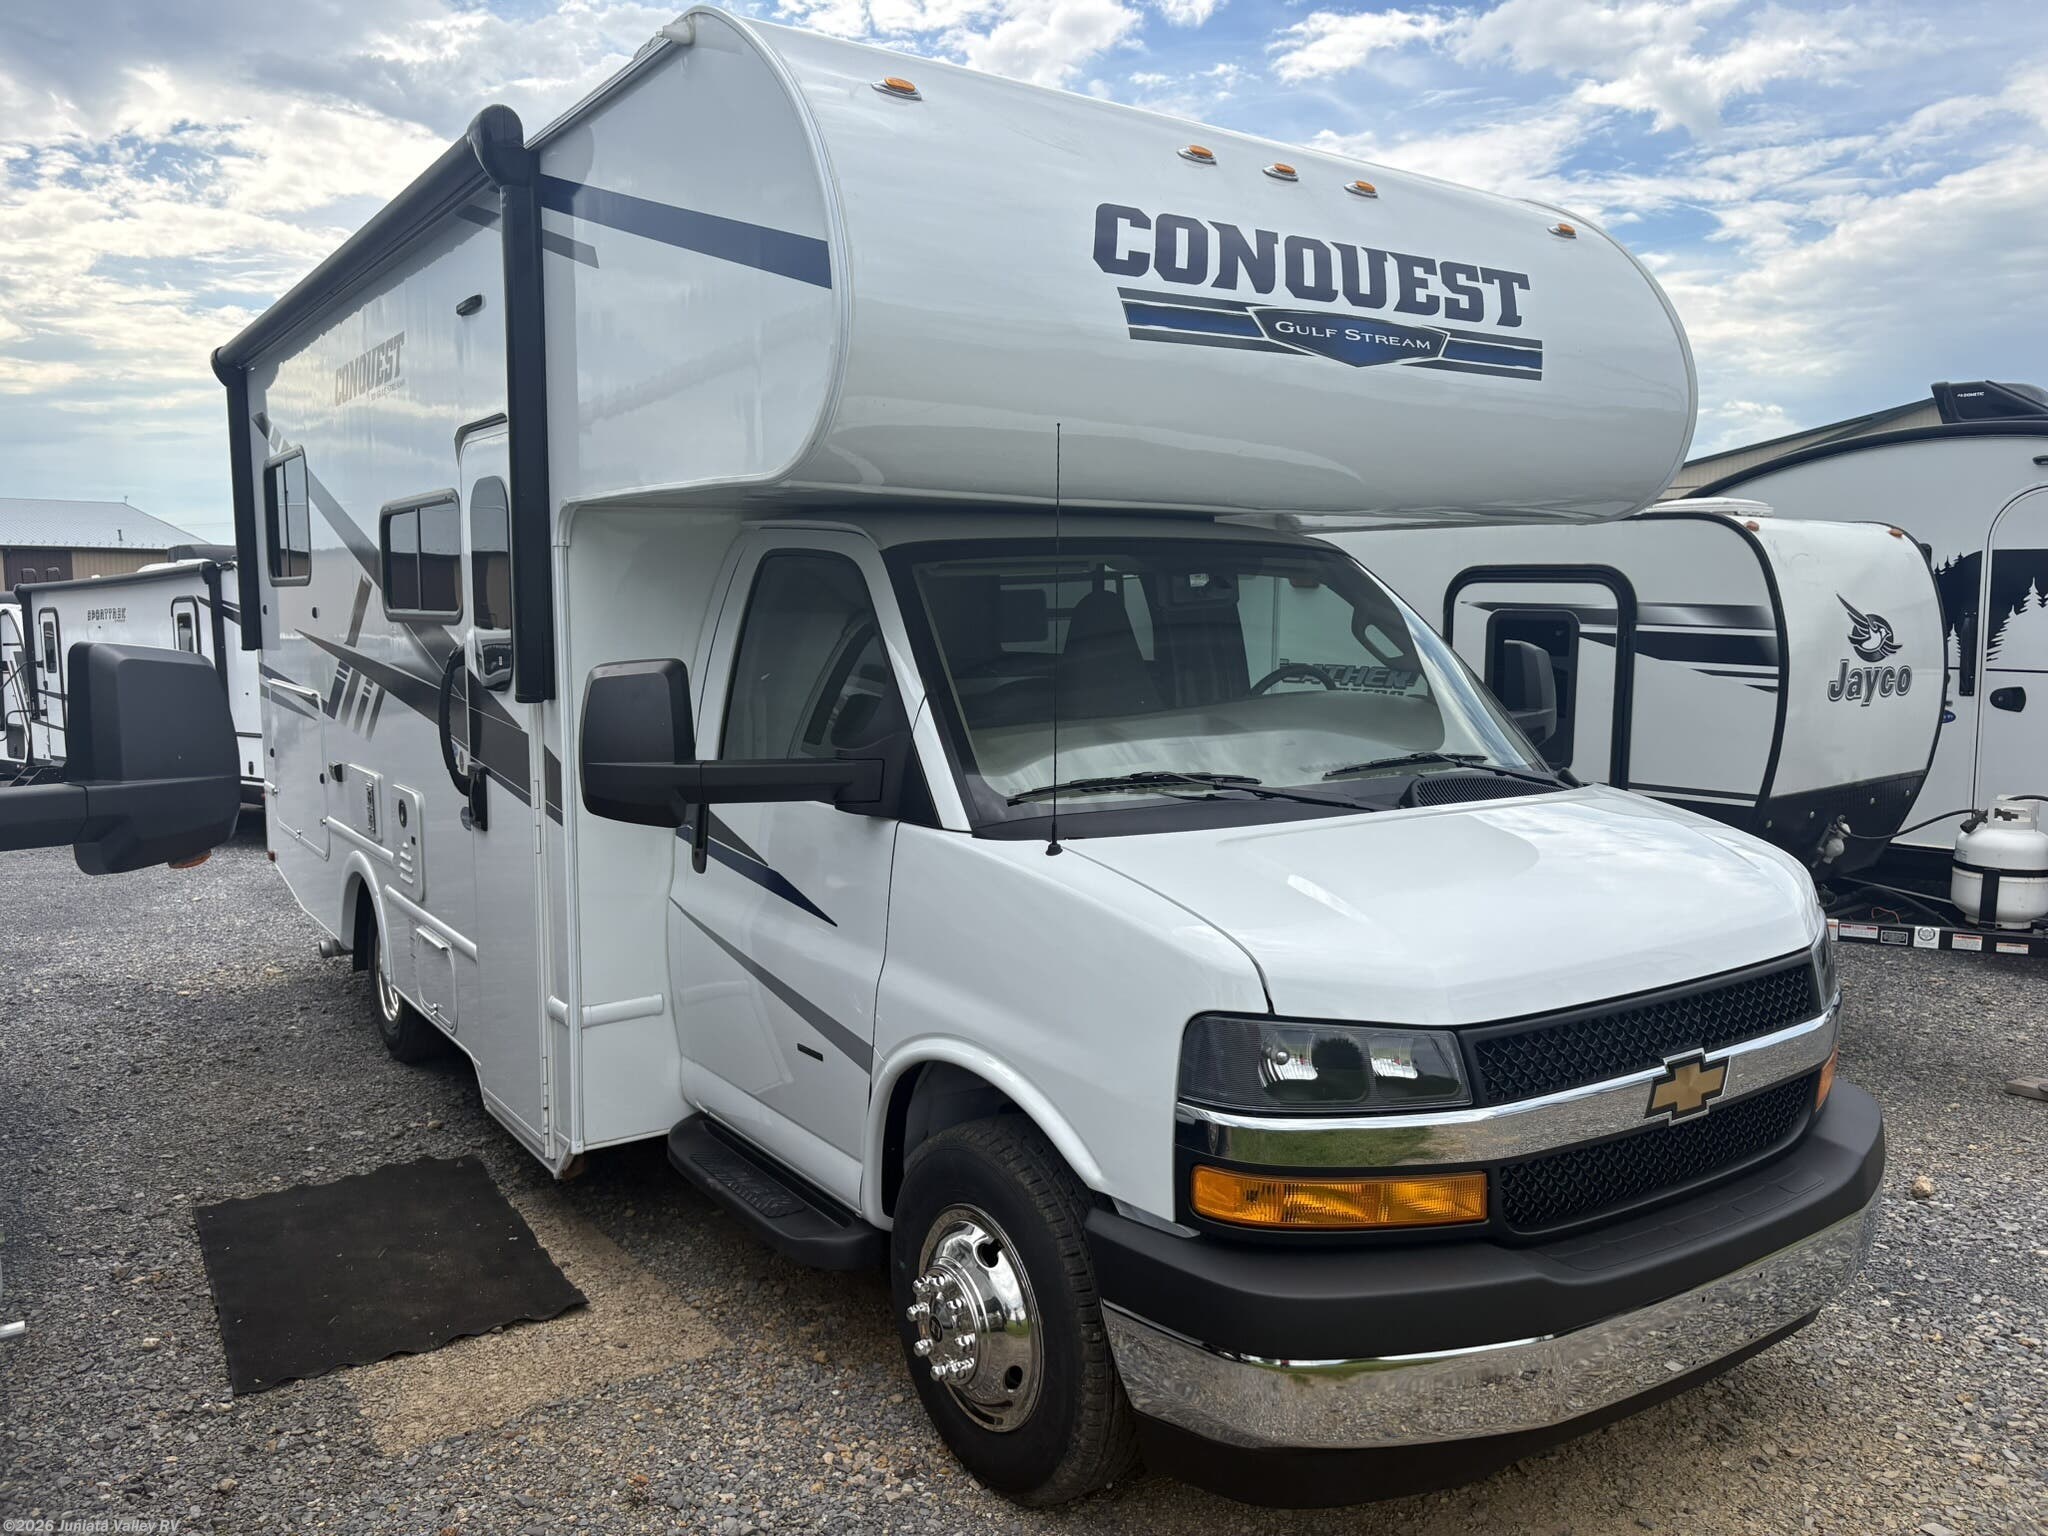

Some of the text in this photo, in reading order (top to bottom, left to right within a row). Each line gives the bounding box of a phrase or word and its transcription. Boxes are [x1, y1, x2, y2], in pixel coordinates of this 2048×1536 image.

[1093, 203, 1530, 328] CONQUEST
[335, 331, 405, 406] CONQUEST
[1827, 658, 1913, 707] Jayco
